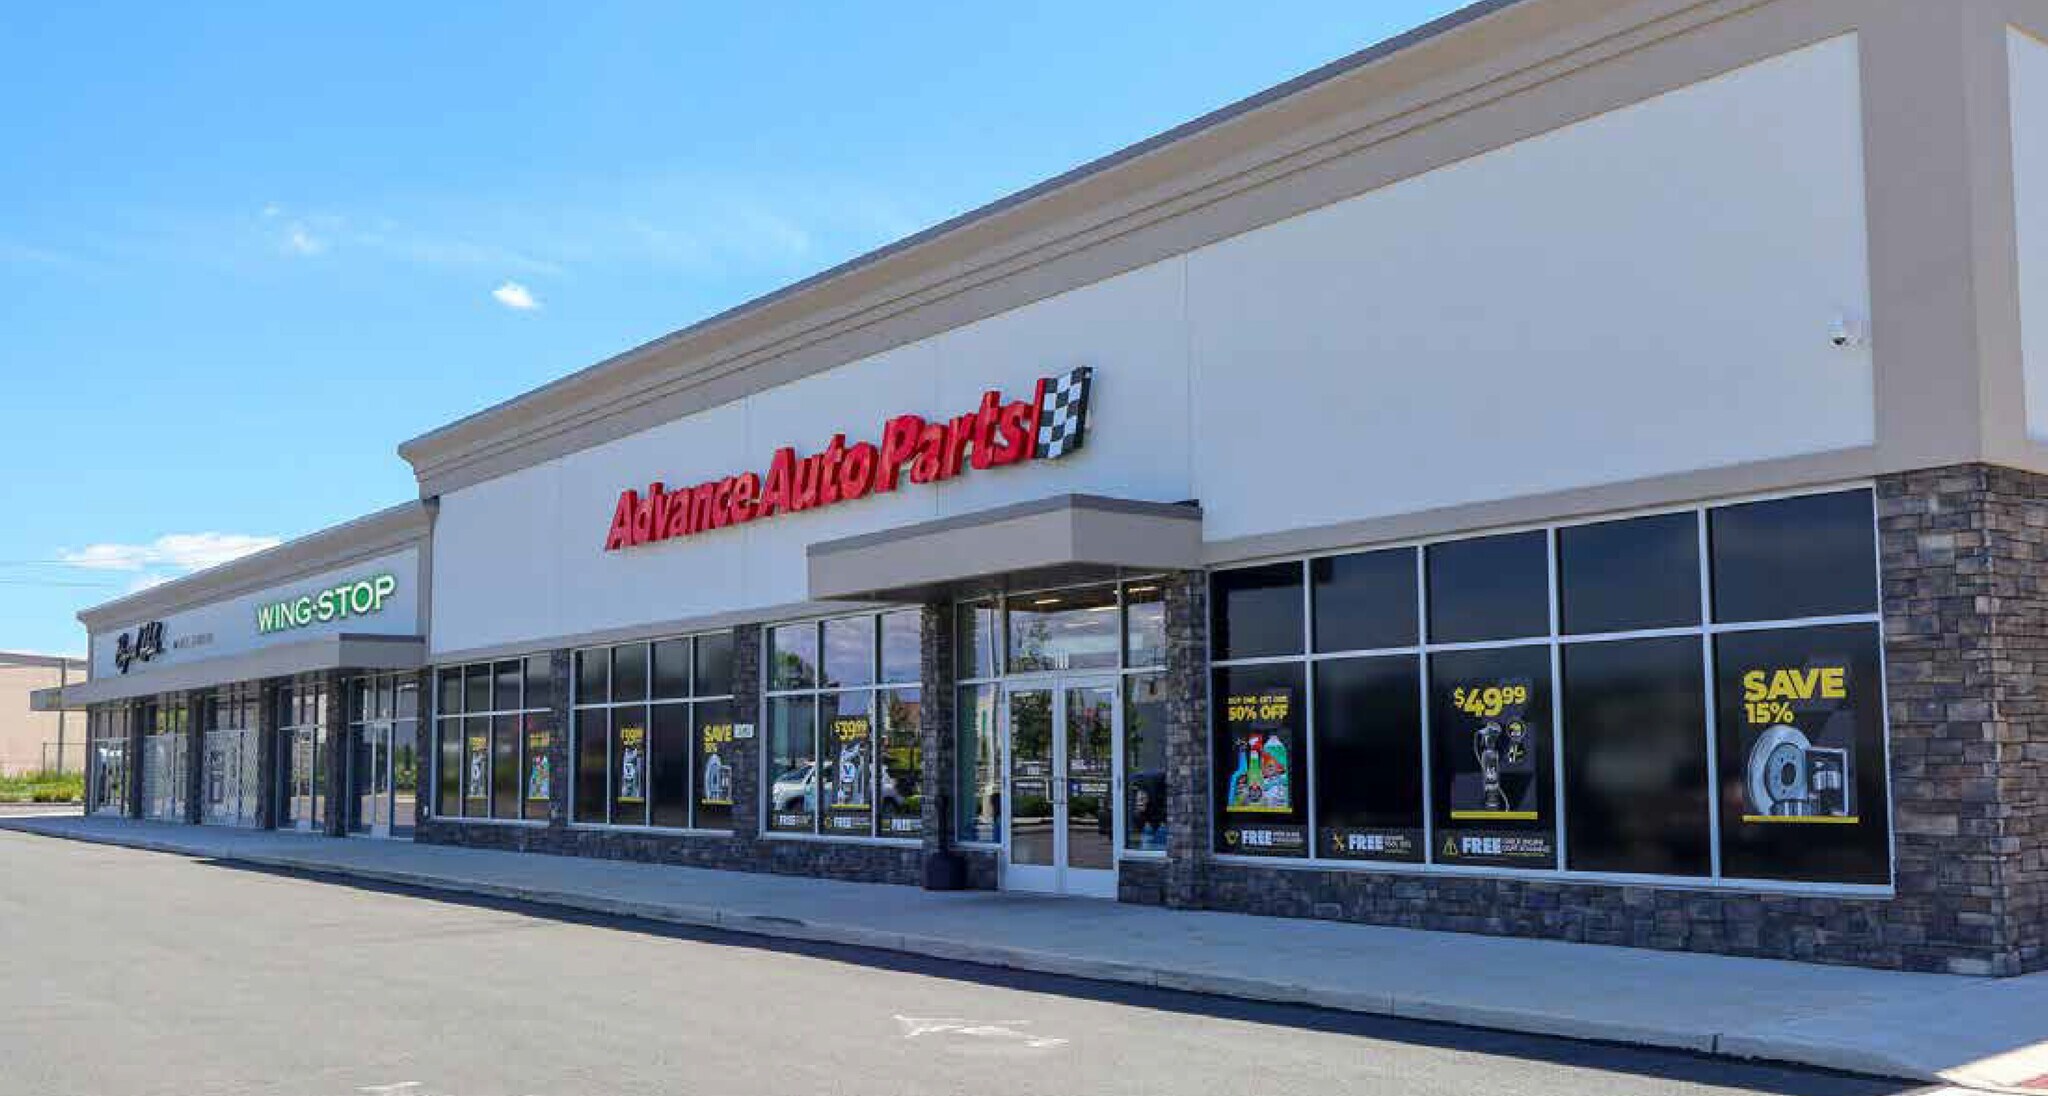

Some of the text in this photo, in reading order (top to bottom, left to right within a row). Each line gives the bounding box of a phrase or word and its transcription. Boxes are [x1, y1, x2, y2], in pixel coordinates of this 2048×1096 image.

[605, 391, 1034, 551] Advance Auto Parts
[1743, 667, 1847, 701] SAVE
[1228, 703, 1288, 721] 50% OFF
[1744, 701, 1795, 724] 15%
[704, 723, 732, 742] SAVE
[1241, 829, 1272, 846] FREE
[1349, 833, 1384, 850] FREE
[1462, 837, 1501, 854] FREE
